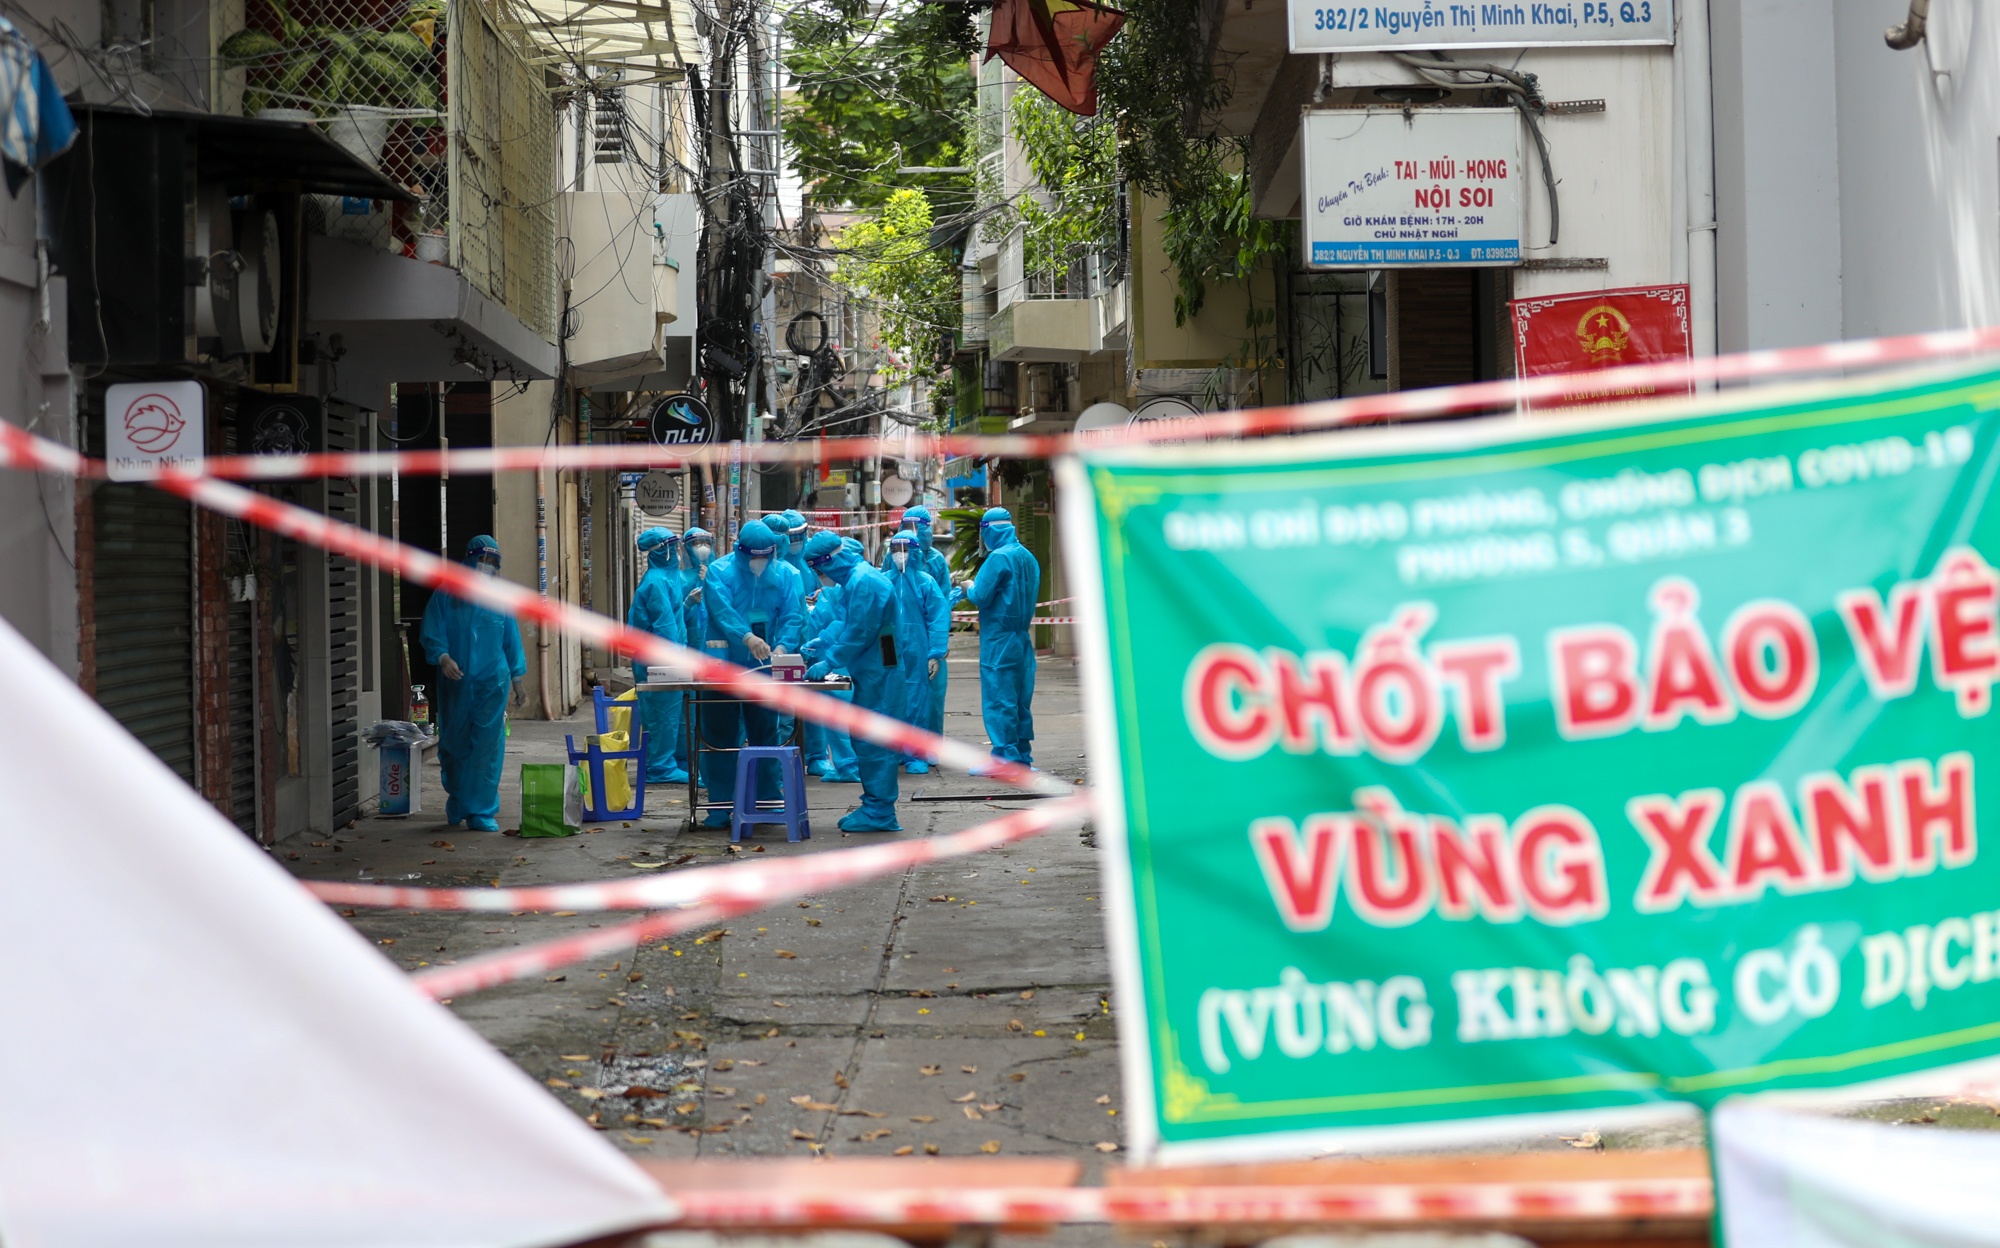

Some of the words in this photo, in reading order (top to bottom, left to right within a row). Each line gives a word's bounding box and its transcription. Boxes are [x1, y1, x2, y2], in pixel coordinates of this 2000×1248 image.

[1315, 8, 1369, 32] 382/2
[1375, 1, 1445, 35] Nguyễn
[1450, 5, 1476, 32] Thị
[1482, 4, 1525, 26] Minh
[1531, 3, 1578, 28] Khai,
[1584, 2, 1614, 27] P.5,
[1620, 1, 1652, 23] Q.3
[1364, 166, 1389, 187] Bệnh:
[1394, 160, 1417, 180] TAI
[1429, 155, 1455, 180] MŨI
[1466, 159, 1507, 183] HỌNG
[1415, 184, 1450, 213] NỘI
[1459, 187, 1493, 208] SOI
[1343, 214, 1362, 226] GIỜ
[1365, 214, 1396, 226] KHÁM
[1400, 213, 1433, 228] BỆNH:
[1435, 216, 1455, 225] 17H
[1464, 215, 1484, 225] 20H
[1374, 227, 1396, 239] CHỦ
[1400, 228, 1428, 240] NHẬT
[1432, 226, 1458, 238] NGHỈ
[1315, 249, 1335, 261] 382/2
[1337, 244, 1369, 261] NGUYỄN
[1371, 249, 1384, 263] THỊ
[1386, 249, 1407, 260] MINH
[1408, 249, 1427, 260] KHAI
[1429, 248, 1441, 260] P.5
[1447, 248, 1460, 260] Q.3
[1797, 425, 1974, 489] COVID-19
[1182, 600, 1521, 764] CHỐT
[1549, 575, 1820, 742] BẢO
[1836, 547, 2000, 719] VỆ
[1248, 785, 1611, 932] VÙNG
[1625, 750, 1977, 914] XANH
[1197, 965, 1435, 1075] (VÙNG
[1450, 952, 1719, 1043] KHÔNG
[1733, 922, 1841, 1025] CÓ
